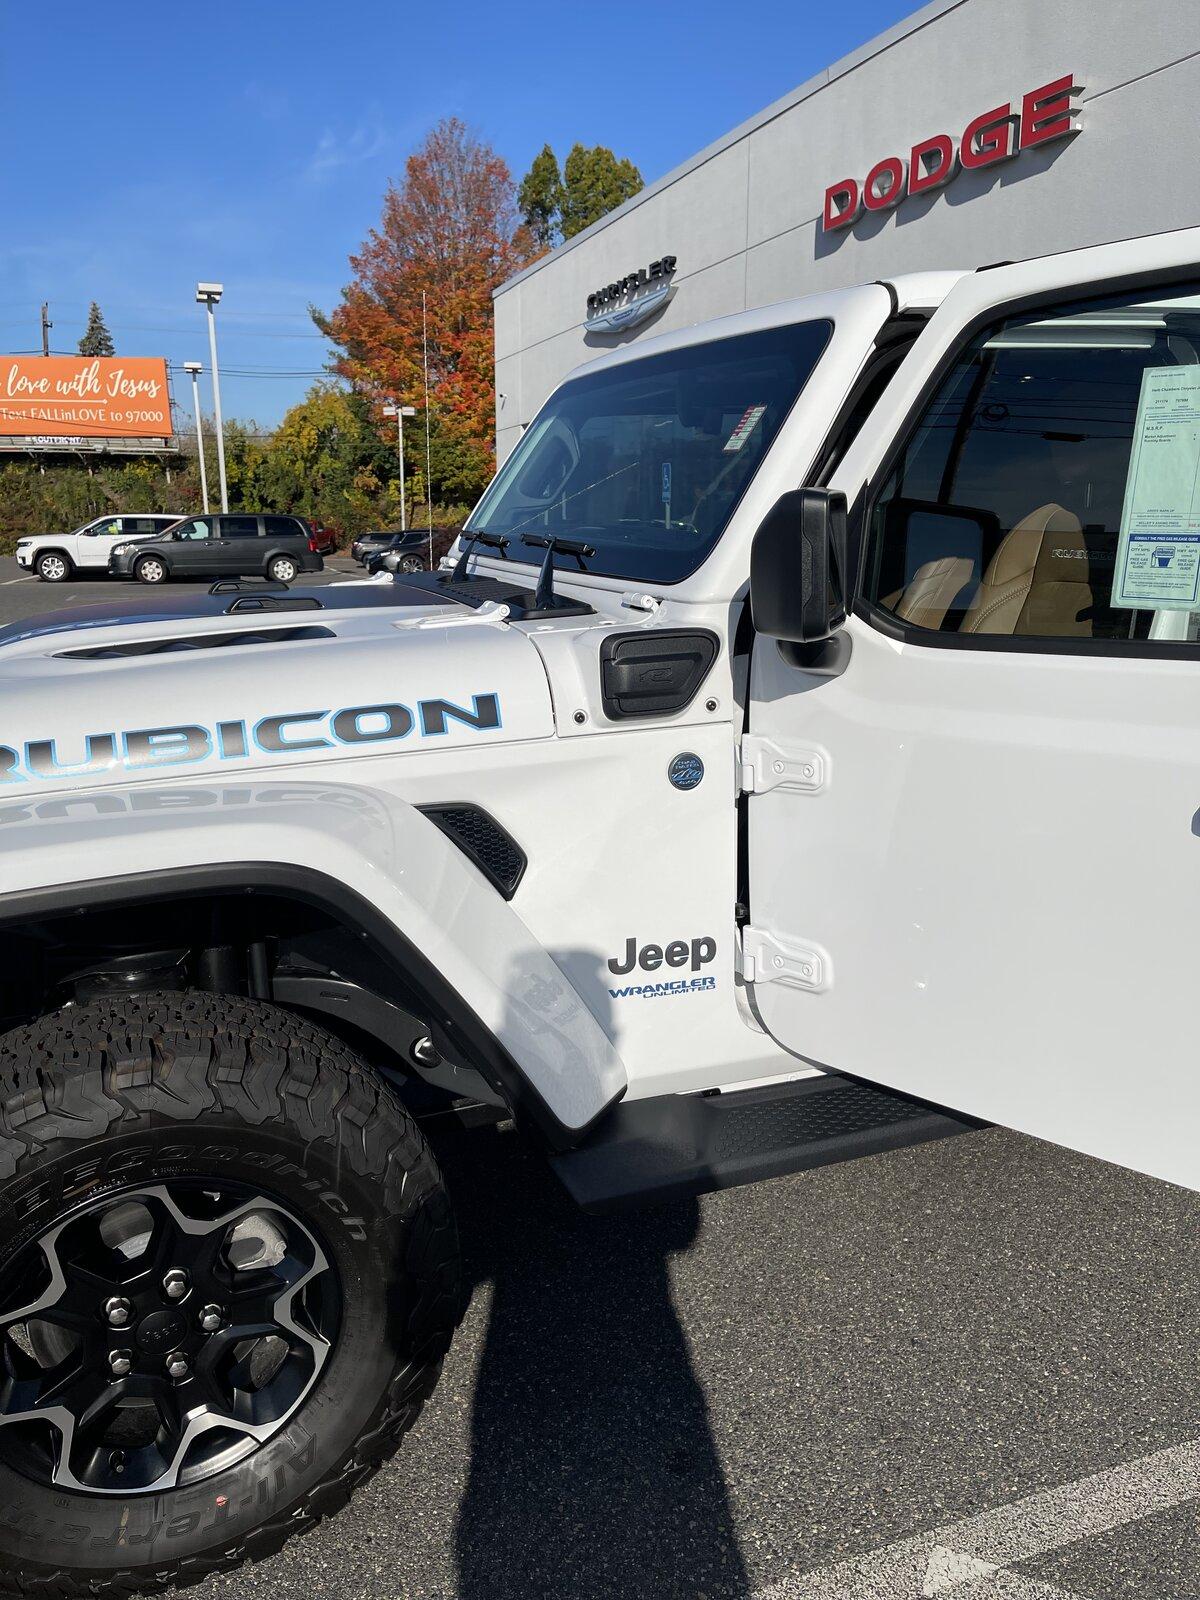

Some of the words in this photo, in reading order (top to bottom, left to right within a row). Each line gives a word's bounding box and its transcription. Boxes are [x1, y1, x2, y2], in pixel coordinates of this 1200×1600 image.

[821, 74, 1082, 232] DODGE
[587, 255, 677, 309] CHRYSLER
[7, 364, 50, 397] love
[56, 360, 101, 398] with
[106, 369, 161, 398] Jesus
[2, 408, 27, 421] Text
[31, 408, 106, 422] FALLinLOVE
[110, 411, 123, 422] to
[125, 410, 164, 424] 97000
[607, 936, 717, 975] Jeep
[608, 976, 717, 998] WRANGLER
[642, 984, 717, 998] UNLIMITED
